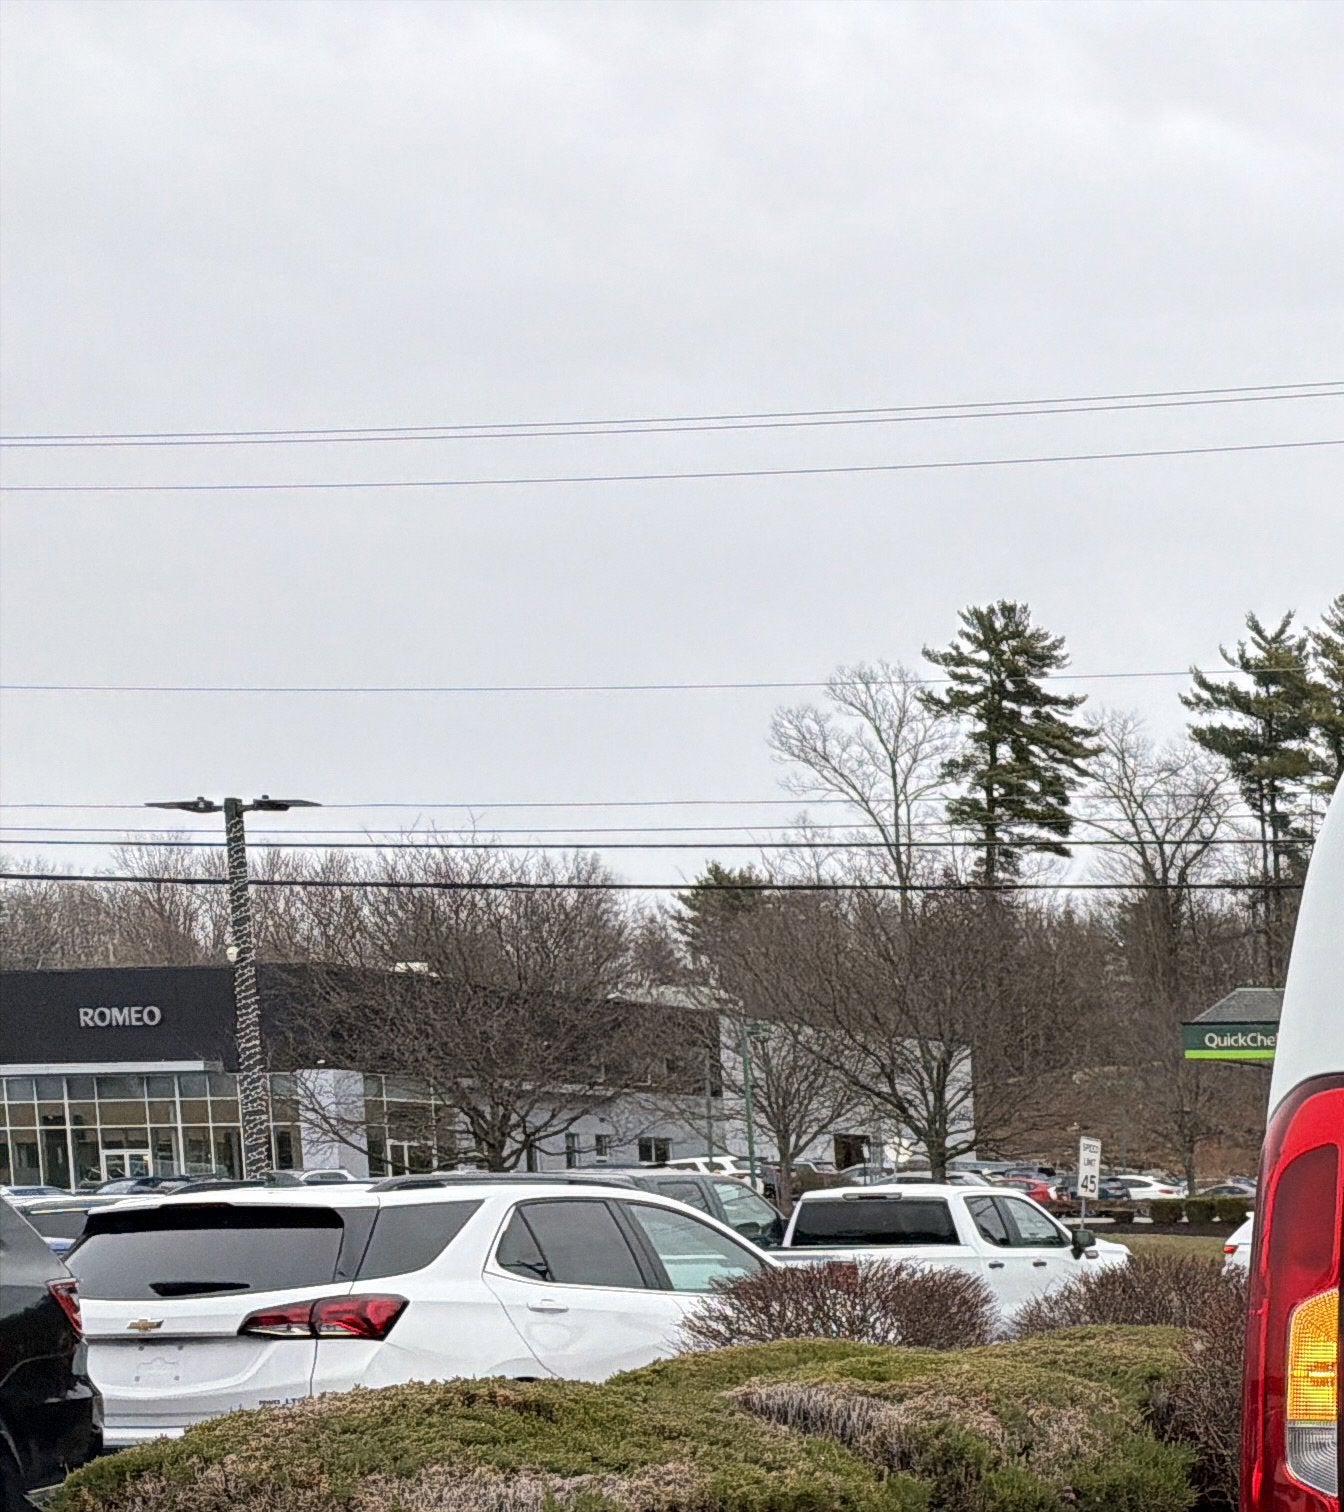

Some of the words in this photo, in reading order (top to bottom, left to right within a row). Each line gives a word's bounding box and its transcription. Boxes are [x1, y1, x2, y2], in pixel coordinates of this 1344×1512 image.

[78, 1005, 162, 1027] ROMEO
[1204, 1032, 1279, 1049] QuickChe
[1080, 1174, 1097, 1193] 45
